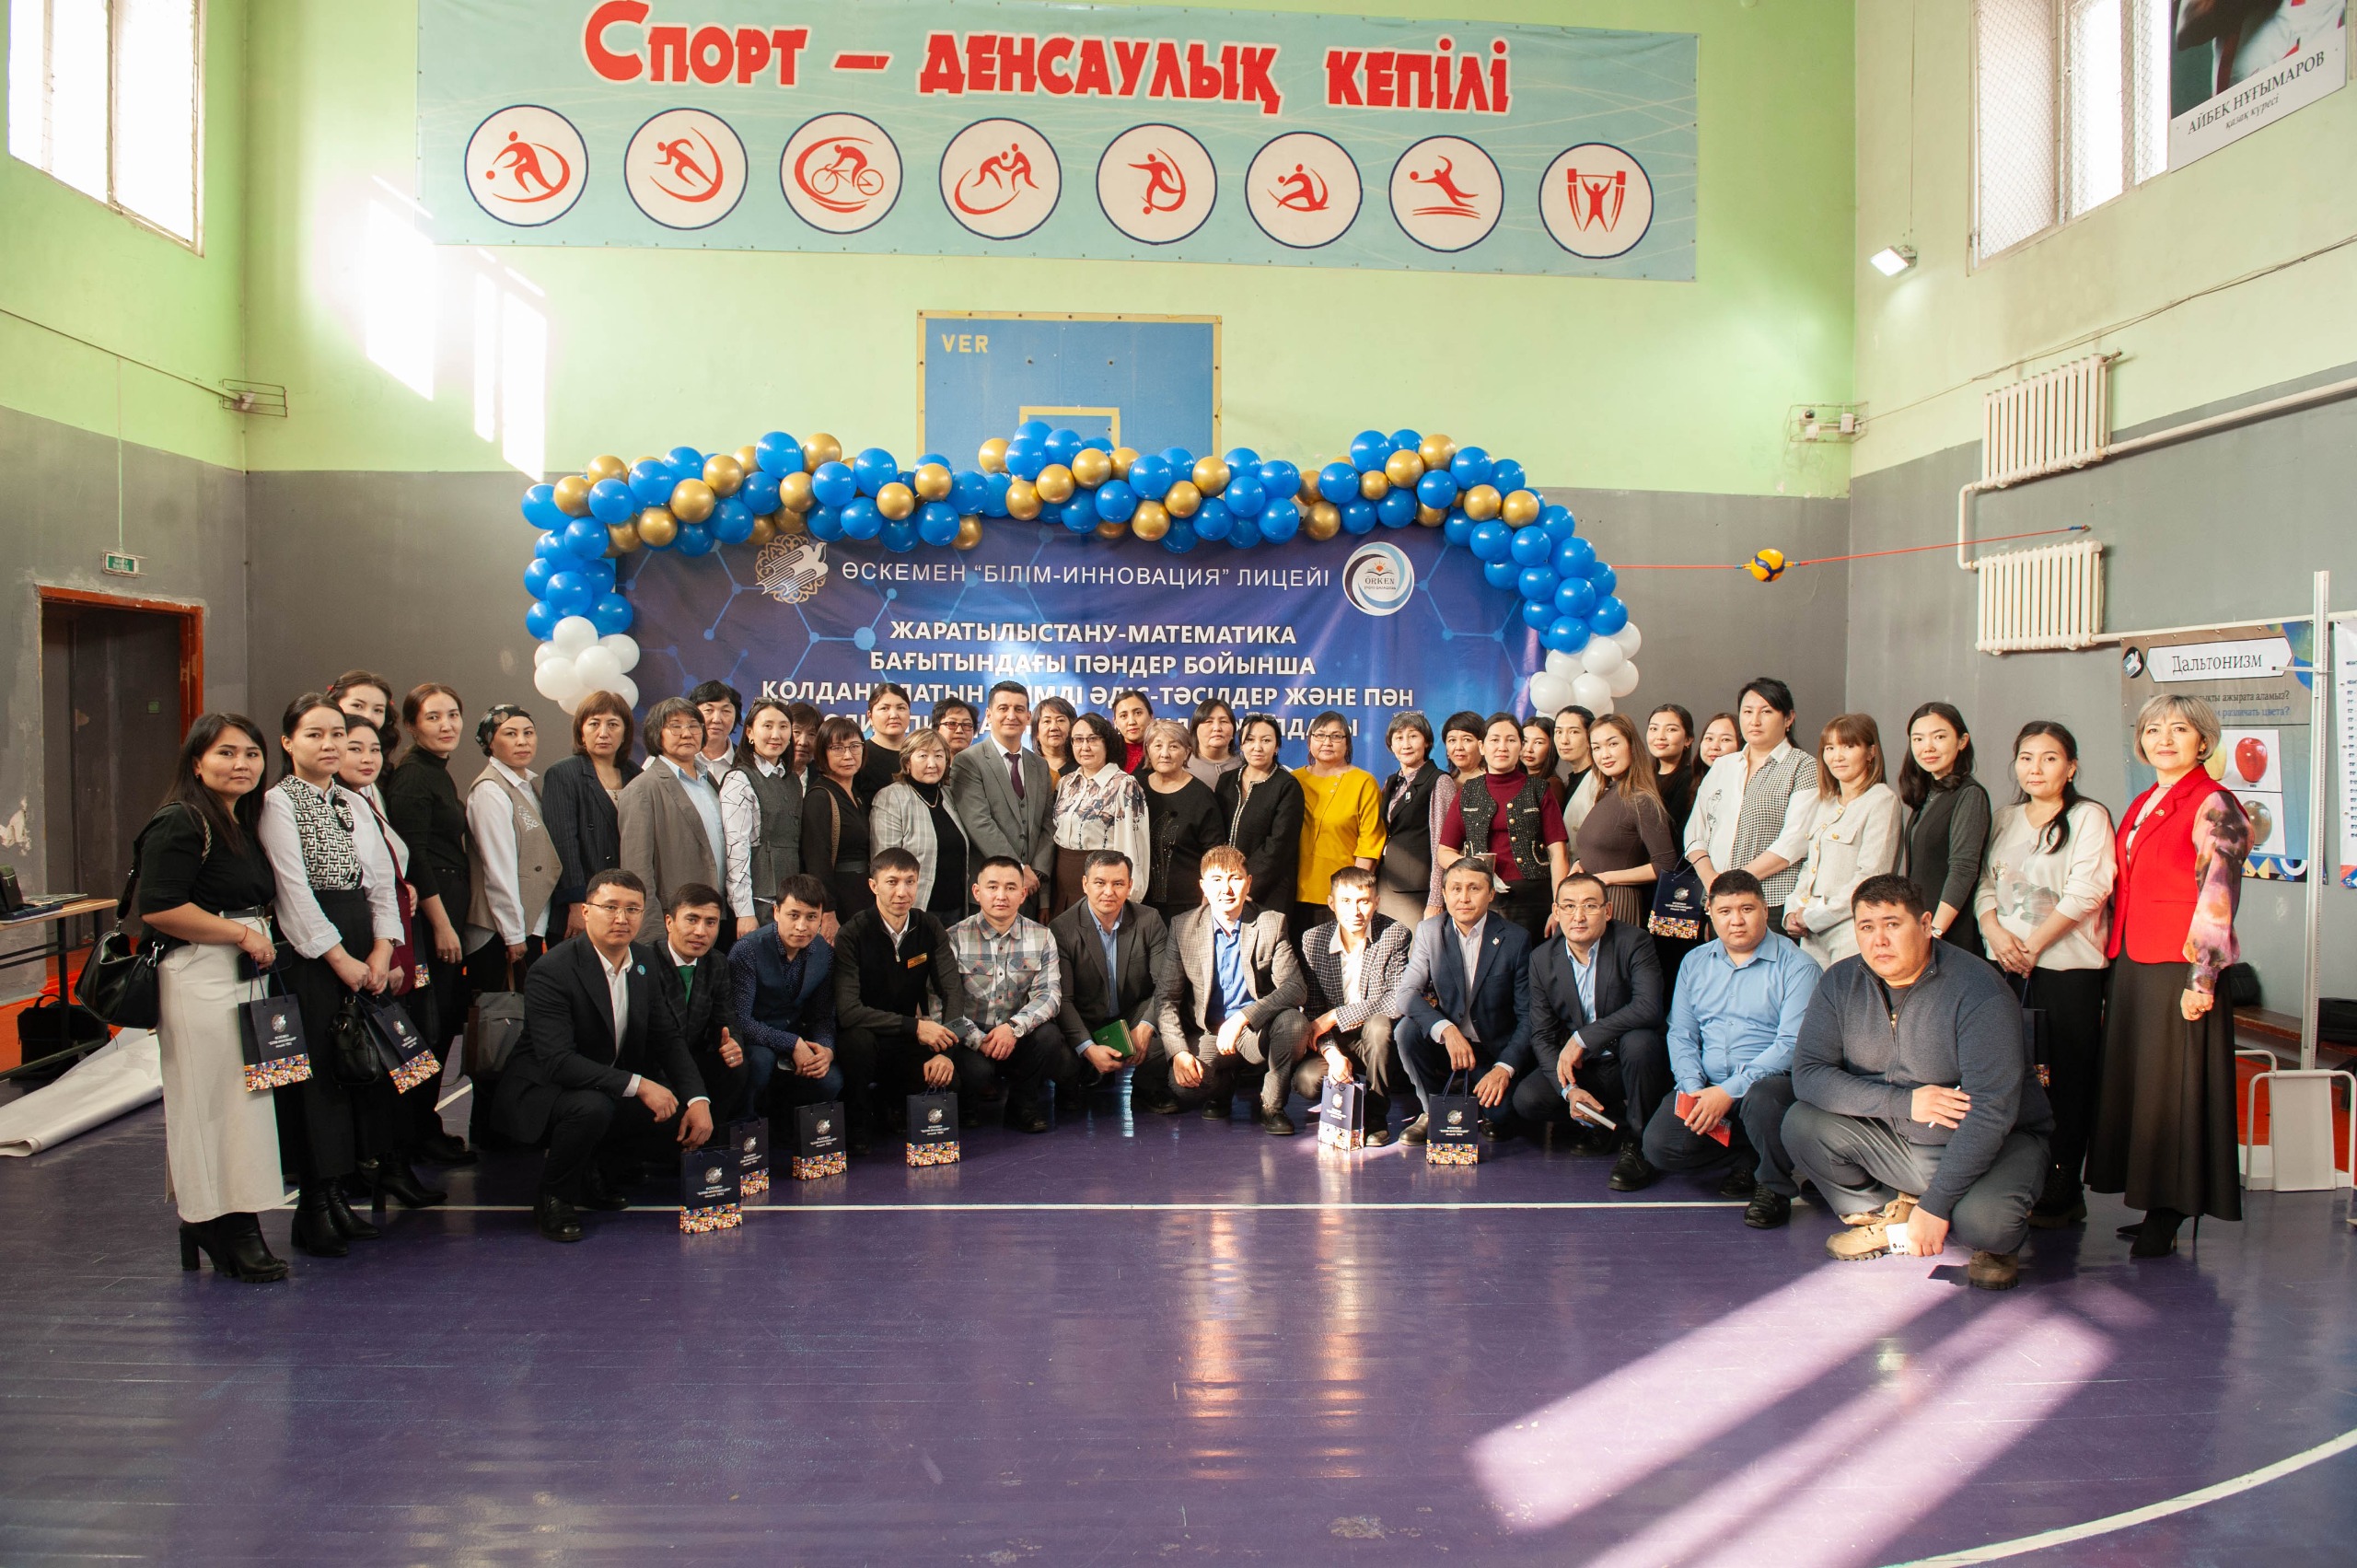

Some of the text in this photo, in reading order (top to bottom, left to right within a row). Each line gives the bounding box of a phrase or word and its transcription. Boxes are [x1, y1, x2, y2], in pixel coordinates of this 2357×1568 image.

[2188, 51, 2325, 134] АЙБЕК НҰҒЫМАРОВ
[941, 333, 989, 354] VER
[842, 562, 966, 582] ӨСКЕМЕН
[1237, 566, 1329, 590] ЛИЦЕЙІ
[888, 621, 1297, 645] ЖАРАТЫЛЫСТАНУ-МАТЕМАТИКА
[870, 651, 1317, 679] БАҒЫТЫНДАҒЫ ПӘНДЕР БОЙЫНША
[2171, 654, 2262, 676] Дальтонизм
[762, 680, 983, 704] ҚОЛДАНЛАТЫН
[1283, 687, 1356, 706] ЖӘНЕ
[1364, 688, 1414, 707] ПӘН
